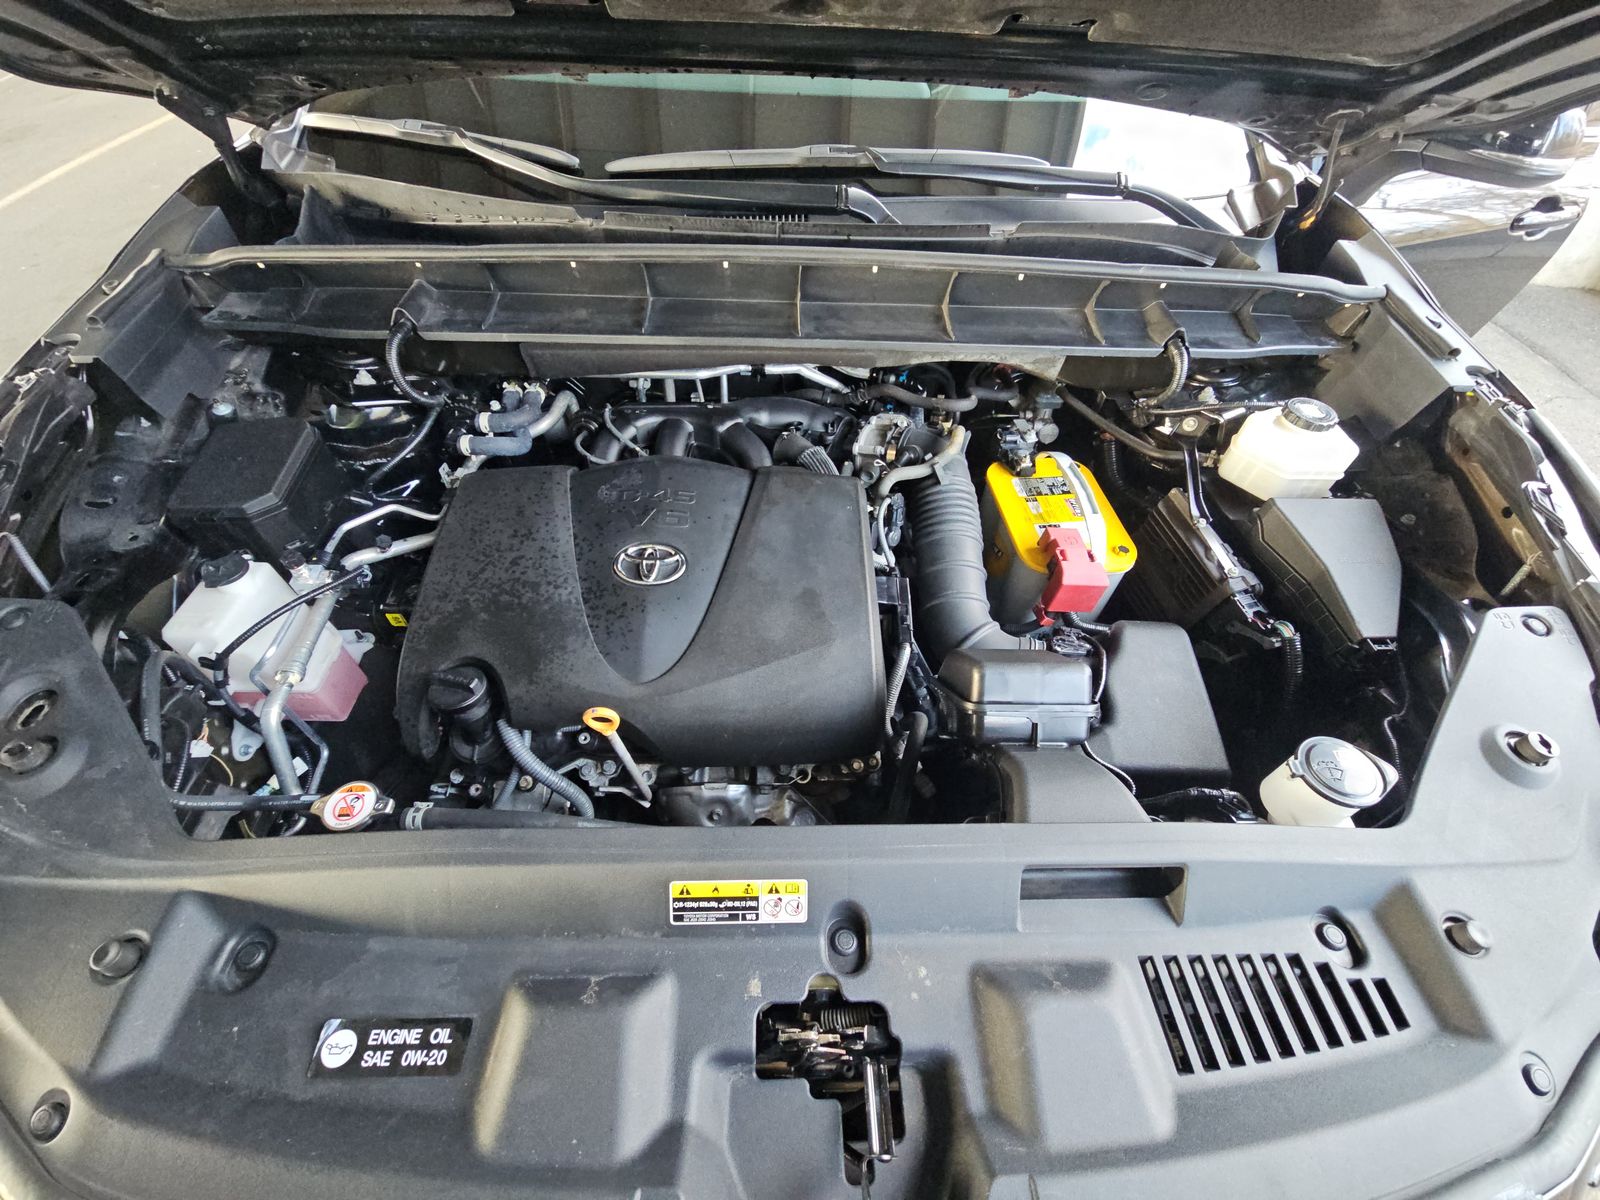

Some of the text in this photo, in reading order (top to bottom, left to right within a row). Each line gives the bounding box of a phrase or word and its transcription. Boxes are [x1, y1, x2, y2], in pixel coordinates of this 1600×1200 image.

[627, 508, 690, 530] V6
[367, 1027, 453, 1046] ENGINE OIL
[360, 1049, 448, 1067] SAE 0W-20
